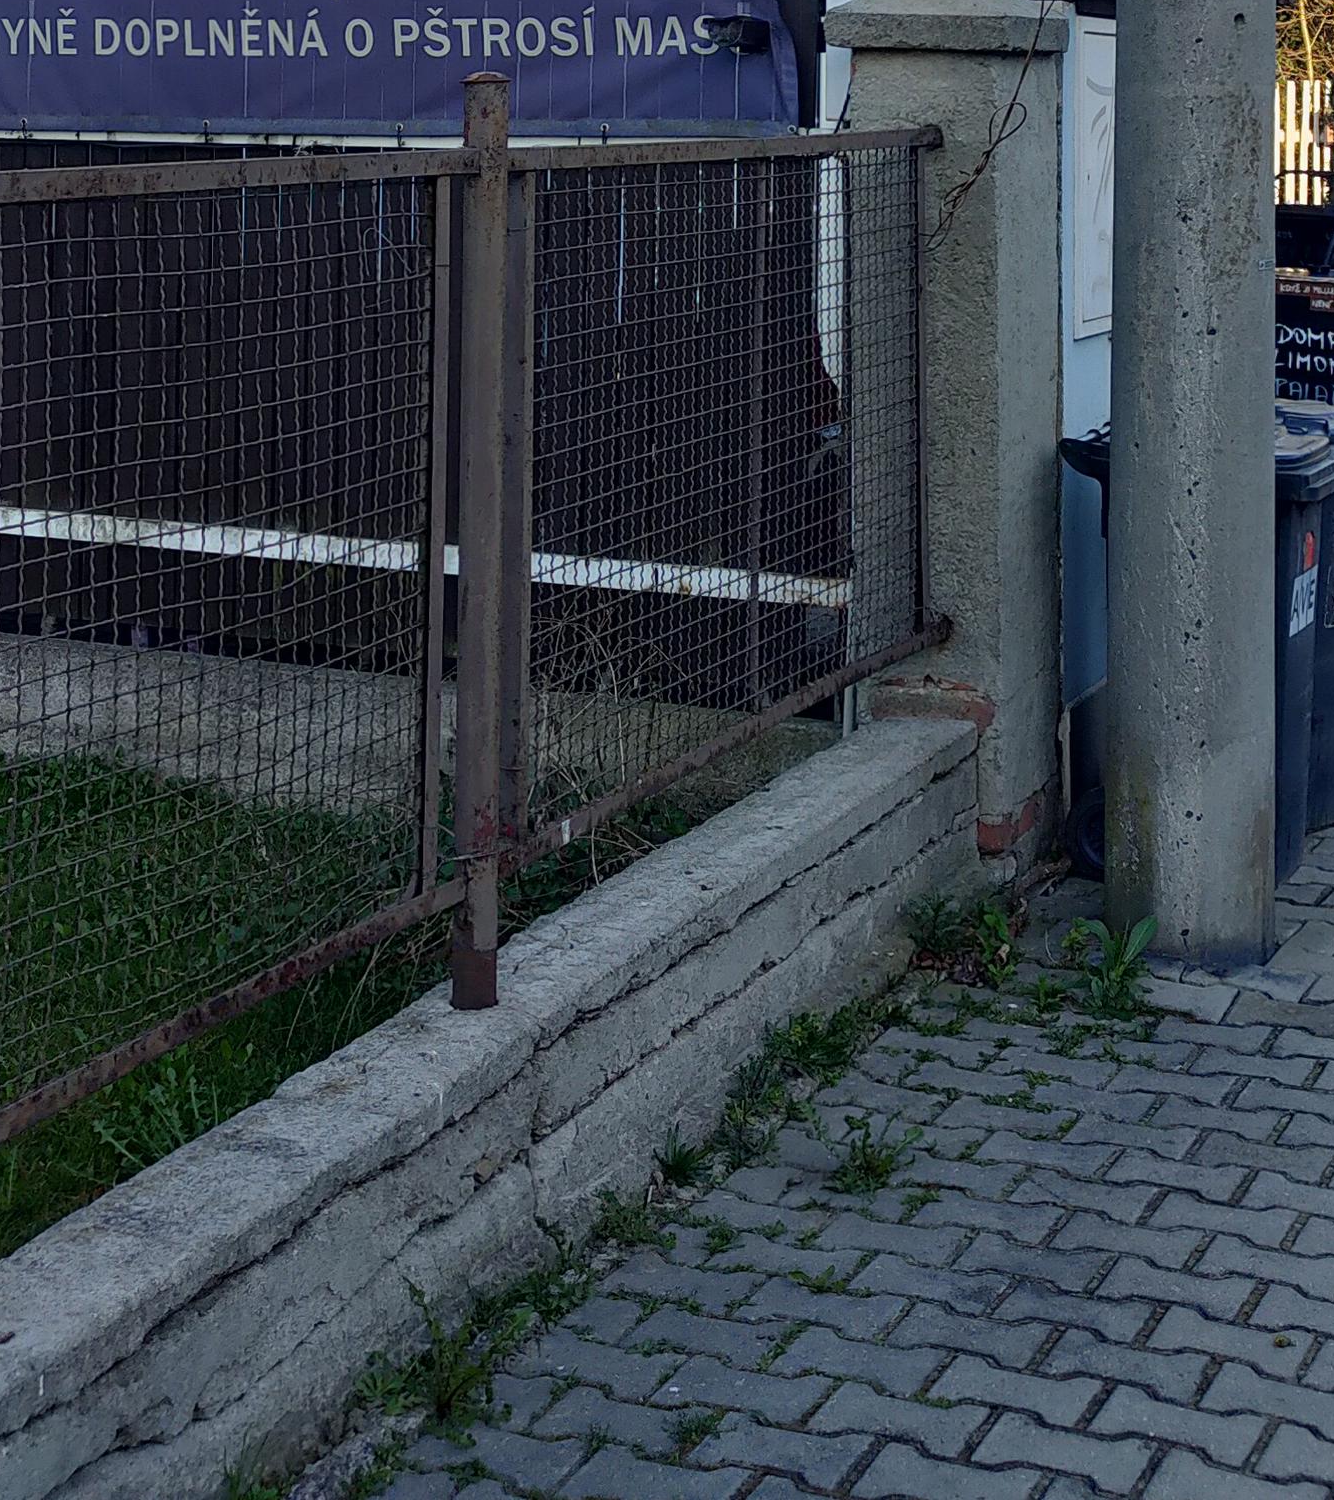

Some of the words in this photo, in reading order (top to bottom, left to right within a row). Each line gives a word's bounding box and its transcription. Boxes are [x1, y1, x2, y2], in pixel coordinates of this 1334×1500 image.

[94, 8, 329, 57] DOPLNĚNÁ
[345, 18, 374, 58] O
[393, 7, 596, 57] PŠTROSÍ
[615, 16, 750, 56] MAS
